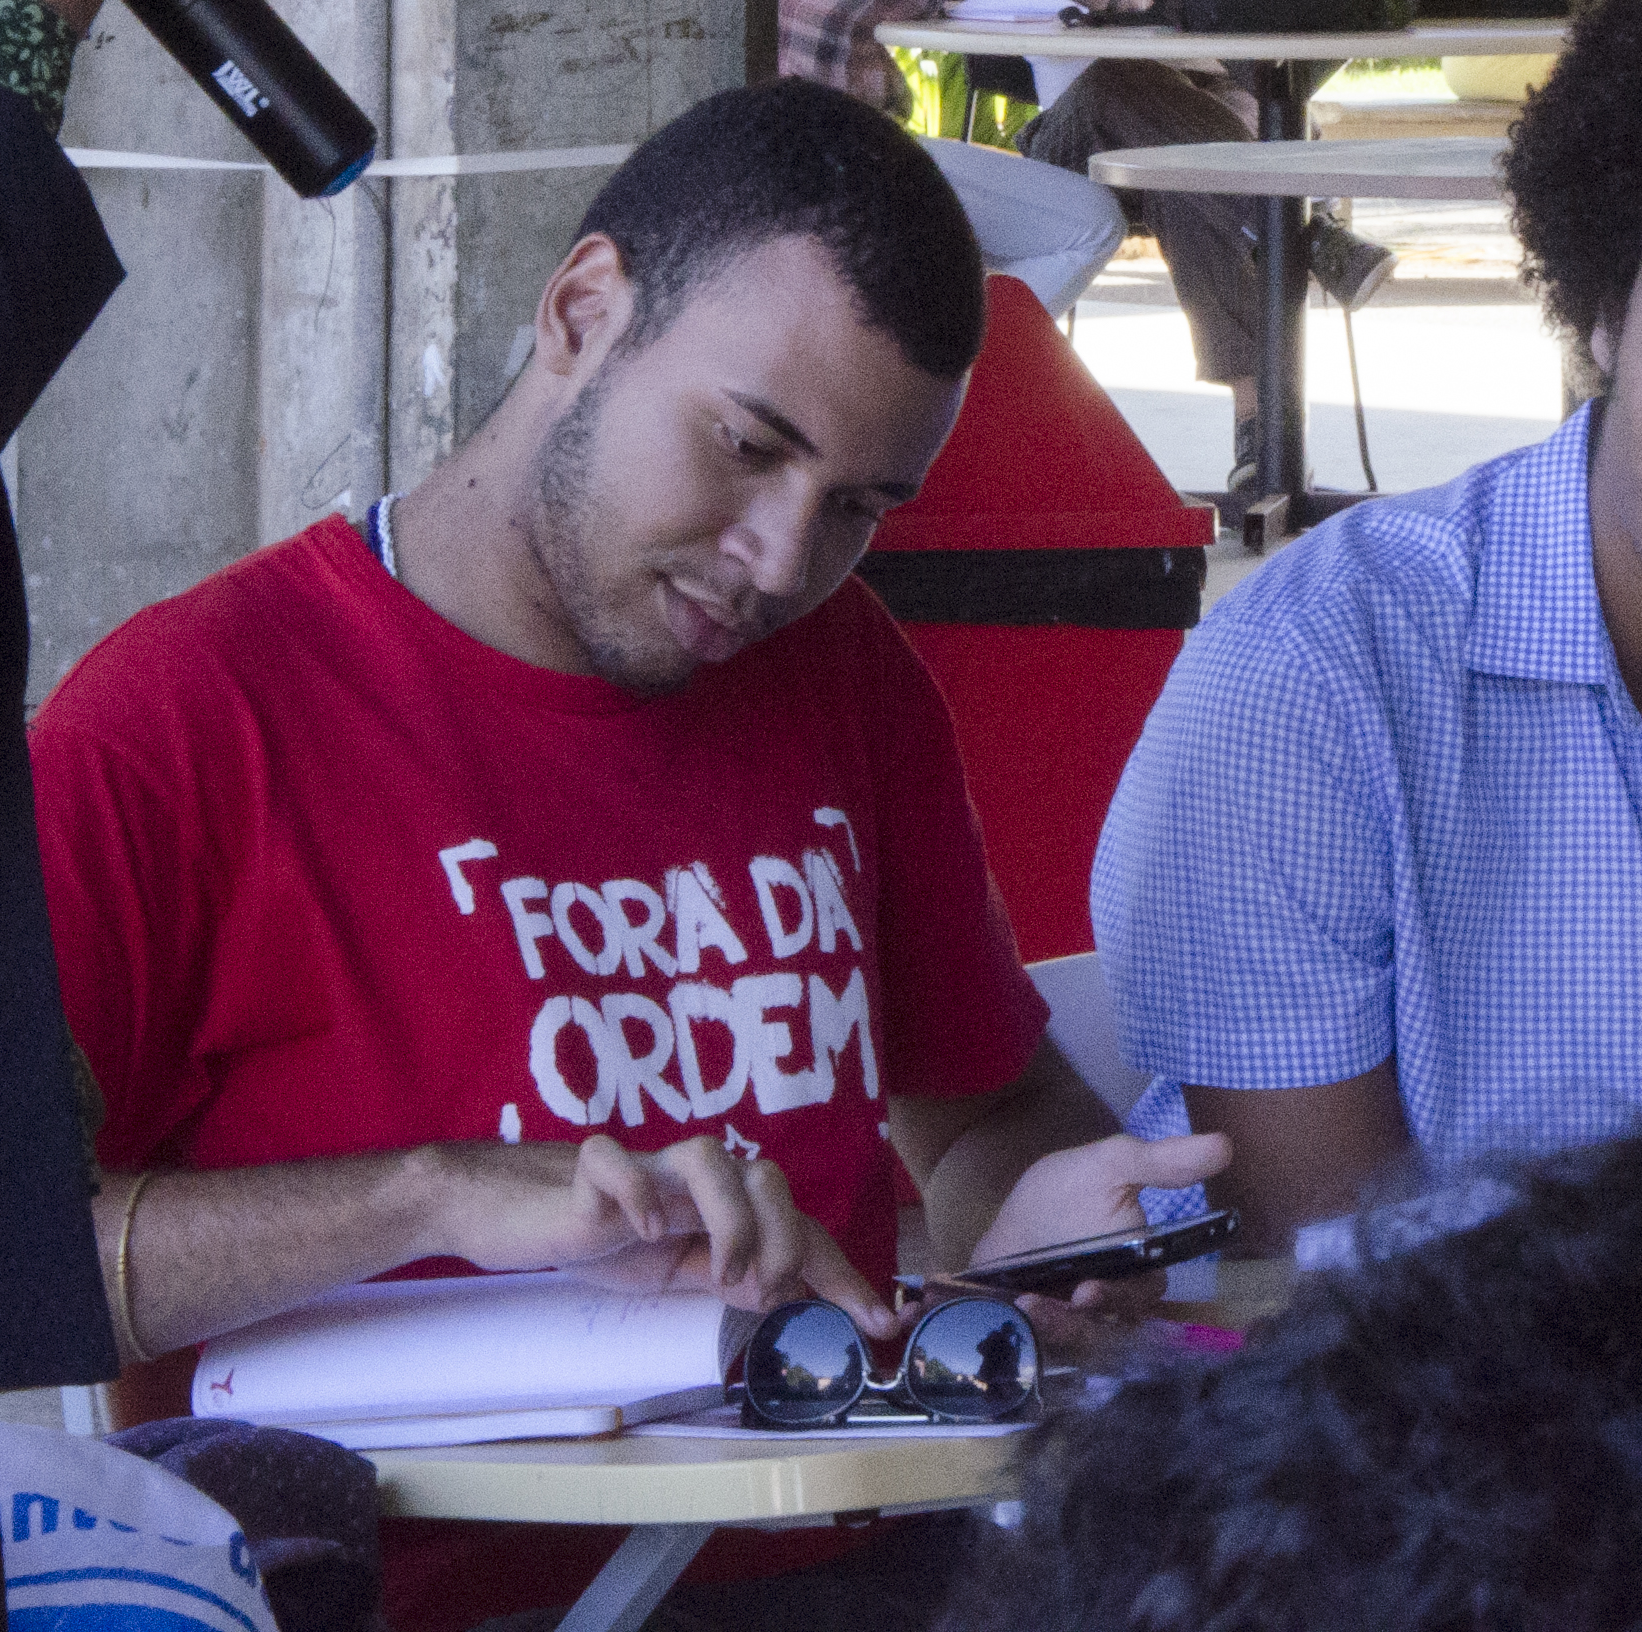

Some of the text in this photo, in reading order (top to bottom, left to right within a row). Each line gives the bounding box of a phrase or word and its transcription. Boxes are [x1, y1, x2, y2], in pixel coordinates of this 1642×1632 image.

[499, 847, 864, 980] FORA DA
[528, 966, 880, 1129] ORDEM
